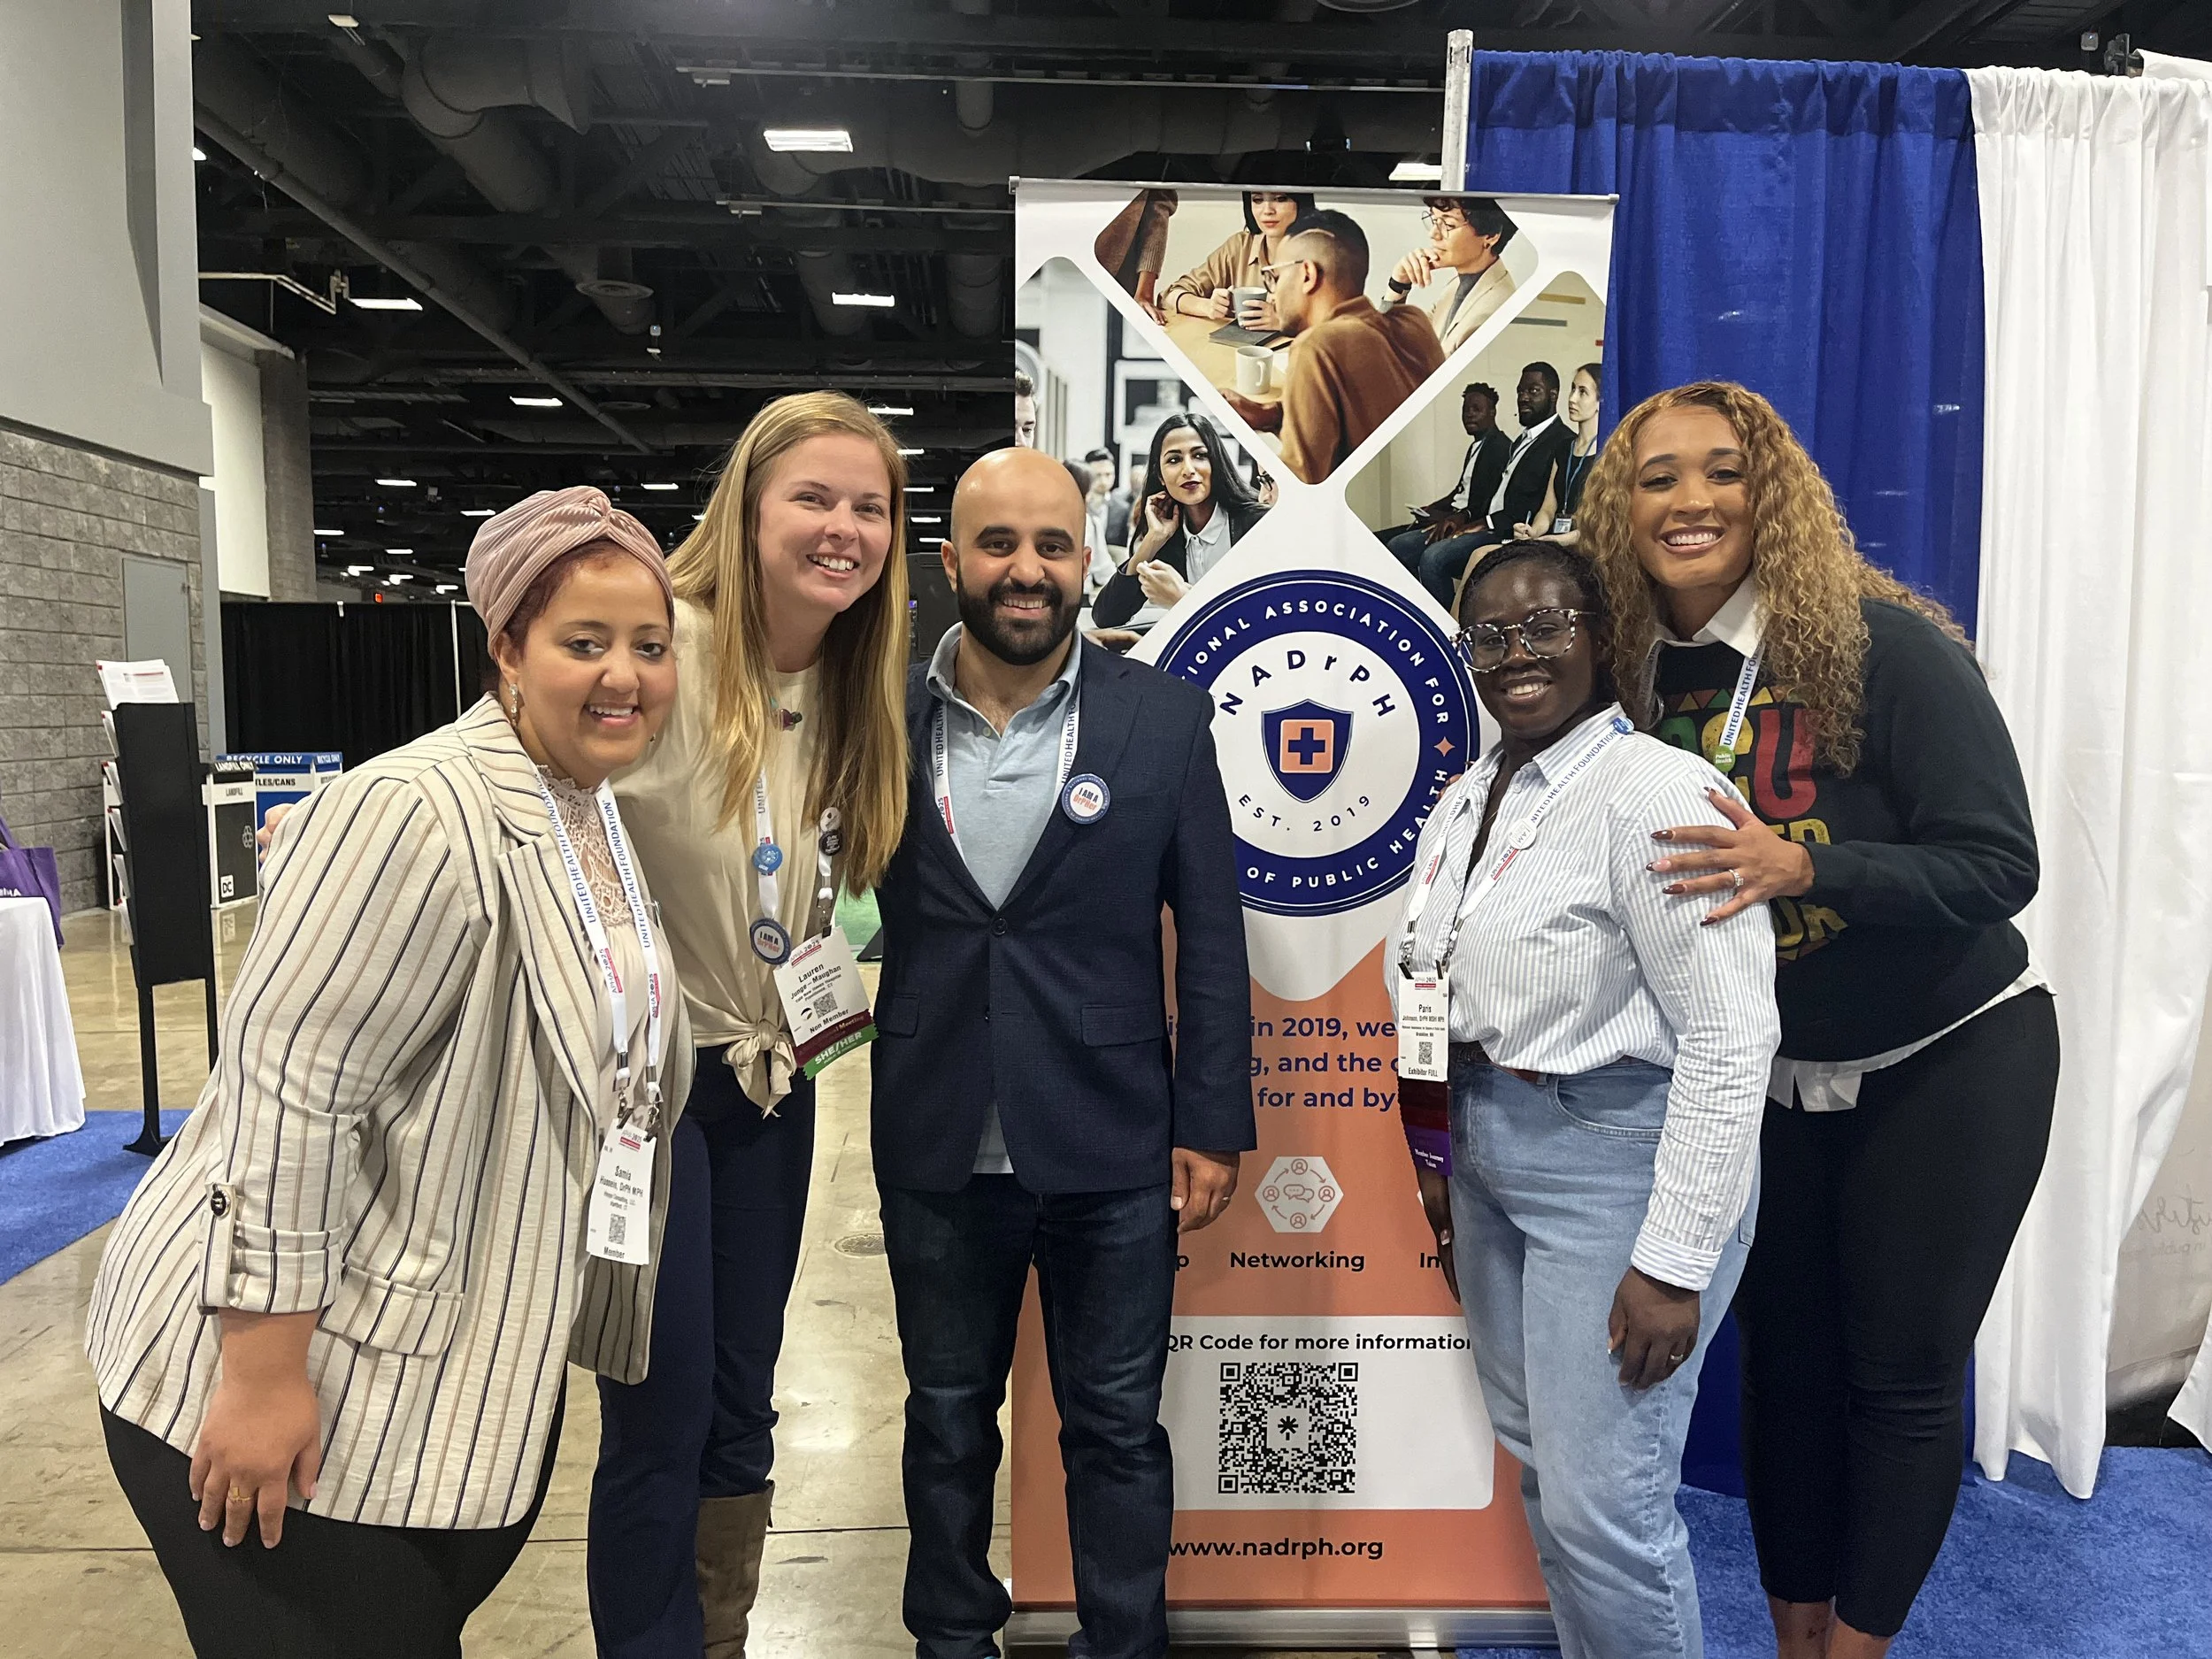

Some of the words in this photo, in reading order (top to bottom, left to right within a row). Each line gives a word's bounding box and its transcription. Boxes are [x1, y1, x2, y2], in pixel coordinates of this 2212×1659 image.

[1184, 618, 1251, 677] IONAL
[1265, 600, 1425, 667] ASSOCIATION
[1425, 677, 1449, 724] FOR
[1219, 649, 1396, 718] NADrPH
[1724, 710, 1740, 746] UNITED
[1734, 673, 1752, 710] HEALTH
[1064, 715, 1075, 750] HEALTH
[1531, 799, 1550, 823] NITED
[1548, 771, 1577, 800] HEALTH
[1573, 728, 1619, 772] FOUNDATION
[1239, 794, 1291, 832] EST.
[1313, 795, 1370, 832] 2019
[1246, 867, 1276, 884] OF
[1292, 857, 1379, 887] PUBLIC
[1389, 769, 1448, 854] HEALTH
[560, 840, 581, 880] HEALTH
[222, 882, 233, 894] DC
[575, 882, 596, 923] UNITED
[623, 868, 641, 908] HEALTH
[635, 909, 650, 948] UNITED
[791, 984, 807, 1000] Junge
[812, 965, 841, 984] Maughan
[798, 964, 825, 983] Lauren
[810, 1023, 823, 1034] Non
[823, 1008, 849, 1025] Member
[1418, 1004, 1432, 1013] Paris
[1282, 1018, 1348, 1040] 2019,
[1356, 1023, 1396, 1037] we
[814, 1031, 864, 1064] SHE/HER
[1279, 1053, 1328, 1072] and
[1337, 1053, 1382, 1072] the
[1408, 1067, 1427, 1076] Exhibitor
[1258, 1088, 1295, 1108] for
[1303, 1088, 1354, 1108] and
[1363, 1087, 1396, 1112] by
[603, 1246, 625, 1259] Member
[1230, 1251, 1366, 1271] Networking
[1167, 1334, 1194, 1351] QR
[1199, 1334, 1254, 1350] Code
[1259, 1334, 1289, 1350] for
[1294, 1338, 1350, 1350] more
[1169, 1538, 1384, 1560] www.nadrph.org
